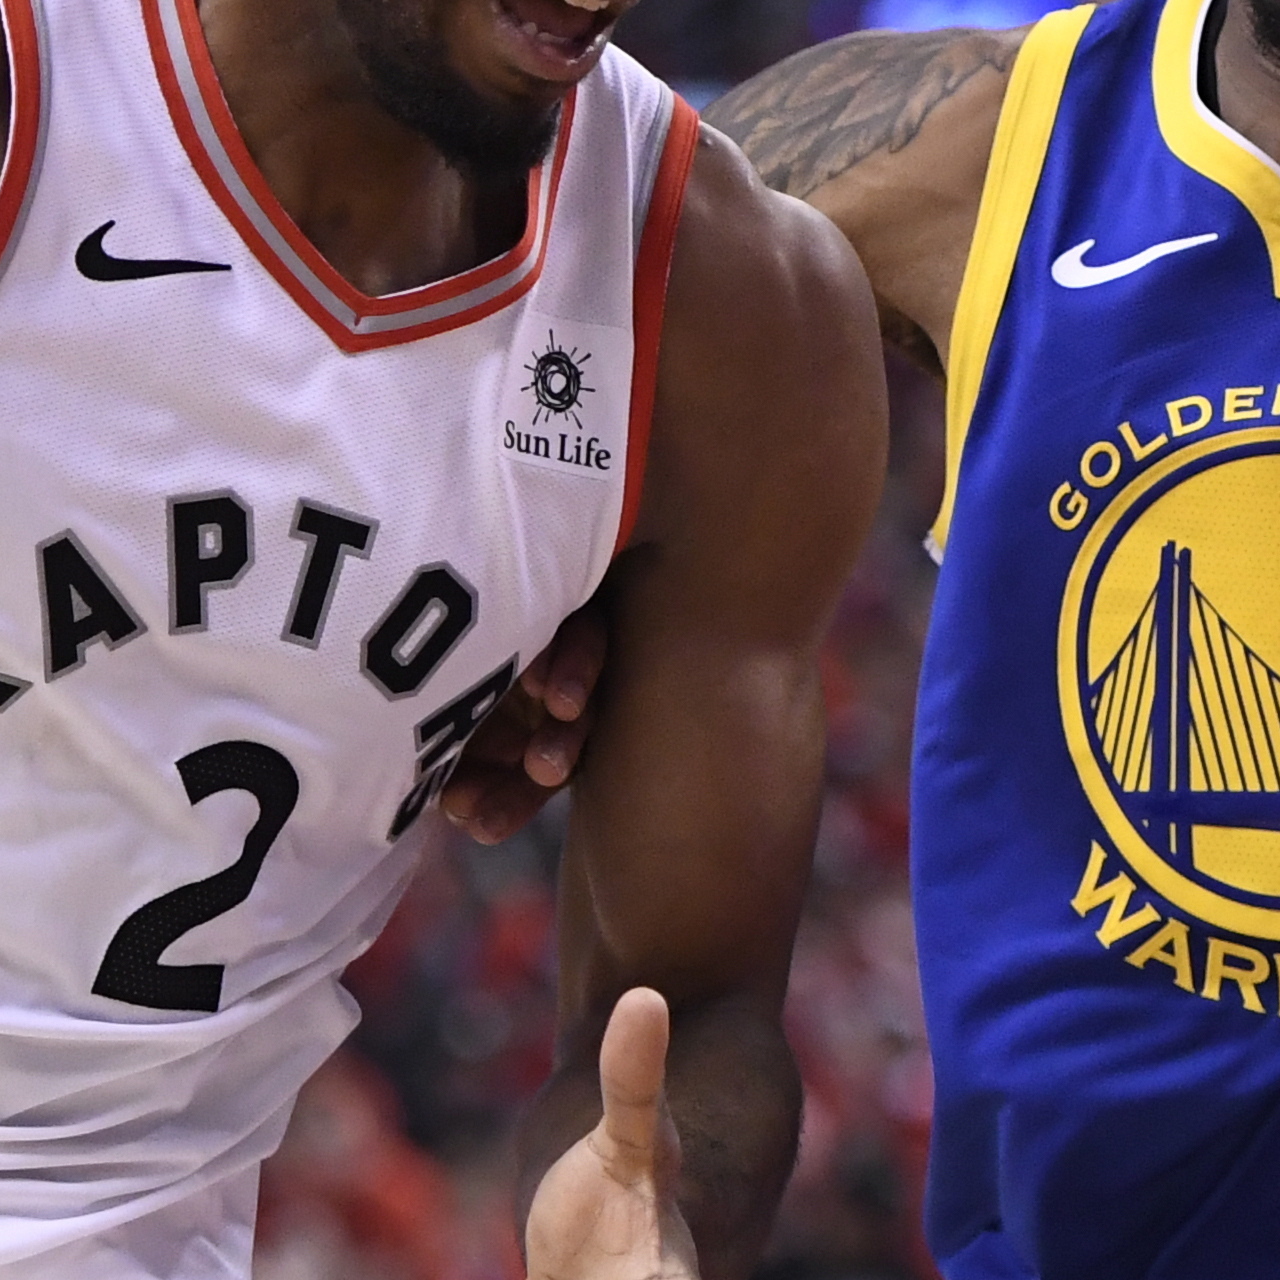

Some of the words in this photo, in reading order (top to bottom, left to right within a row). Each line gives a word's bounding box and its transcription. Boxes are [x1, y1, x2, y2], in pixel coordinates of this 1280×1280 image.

[503, 419, 551, 459] Sun
[557, 432, 612, 471] Life
[91, 739, 300, 1013] 2
